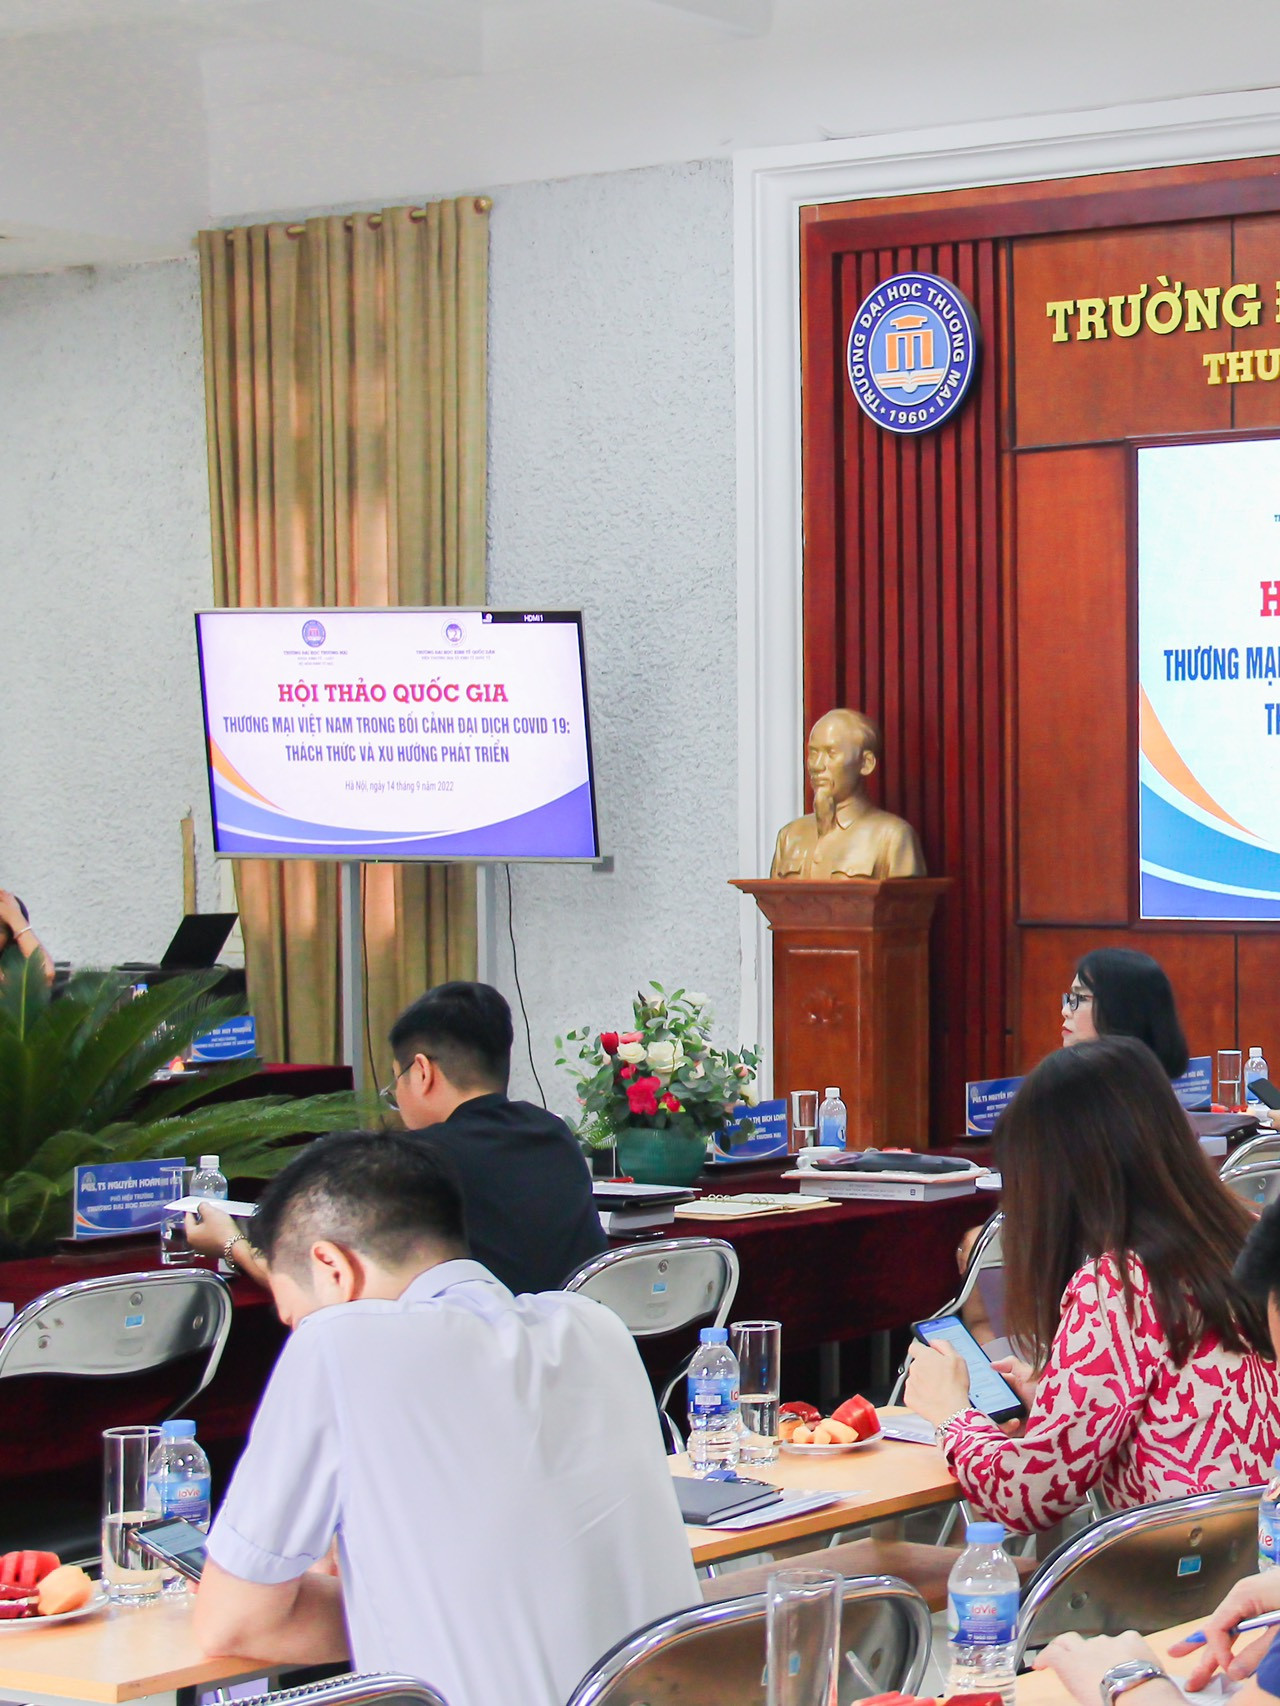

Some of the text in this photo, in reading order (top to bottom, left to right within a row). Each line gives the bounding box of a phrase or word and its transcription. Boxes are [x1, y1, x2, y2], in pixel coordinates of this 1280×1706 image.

[1046, 276, 1262, 342] TRƯỜNG
[886, 283, 923, 301] HỌC
[935, 369, 962, 407] MẠI
[889, 409, 928, 424] 1960
[1164, 645, 1240, 681] THƯƠNG
[278, 677, 509, 707] HỘI THẢO QUỐC GIA
[223, 711, 571, 738] THƯƠNG MẠI VIỆT NAM TRONG BỐI CẢNH ĐẠI DỊCH COVID 19:
[285, 737, 510, 763] THÁCH THỨC VÀ XU HƯỚNG PHÁT TRIỂN
[345, 780, 355, 791] Hà
[388, 781, 395, 791] 14
[416, 781, 421, 791] 9
[437, 781, 454, 791] 2022
